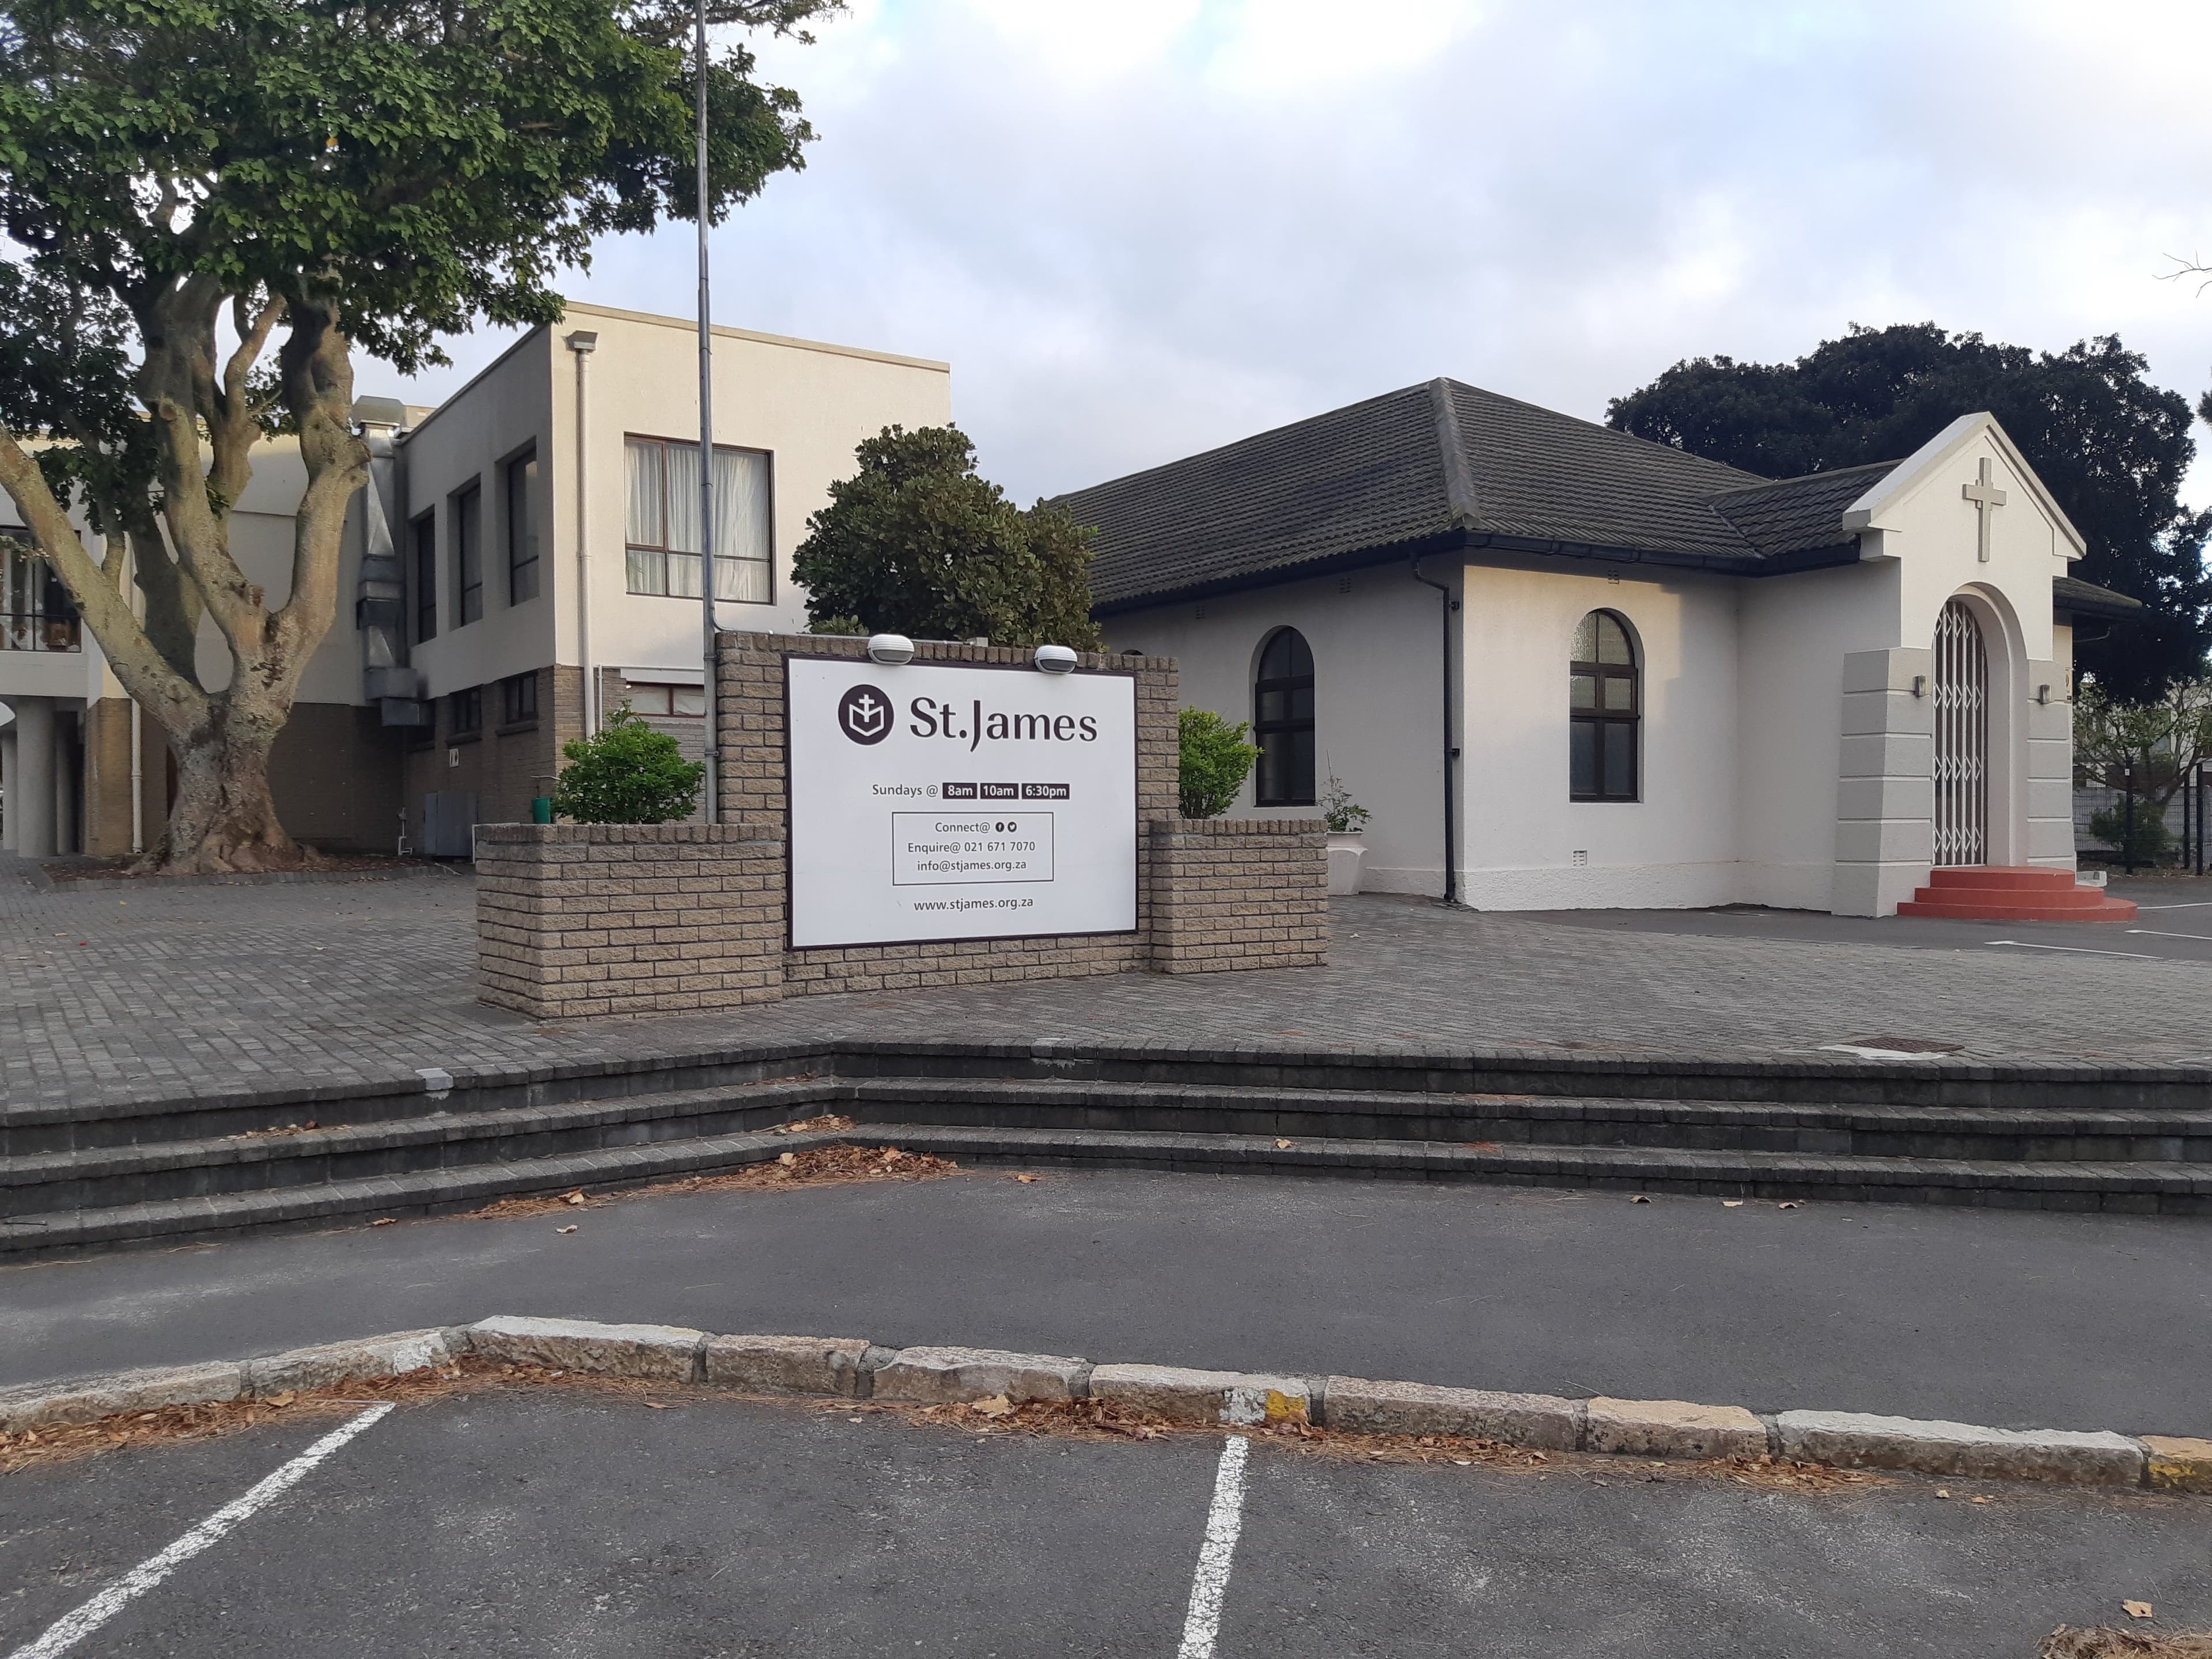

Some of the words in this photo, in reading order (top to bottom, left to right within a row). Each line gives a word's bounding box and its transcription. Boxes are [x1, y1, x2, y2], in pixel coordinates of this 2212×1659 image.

[872, 783, 923, 799] Sundays
[925, 784, 939, 798] @
[948, 785, 974, 797] 8am
[983, 785, 1014, 797] 10am
[1025, 785, 1067, 799] 6:30pm
[934, 821, 991, 835] Connect@
[907, 841, 961, 855] Enquire@
[964, 841, 983, 853] 021
[987, 841, 1006, 852] 671
[1009, 840, 1036, 852] 7070
[917, 859, 1027, 873] info@stjames.org.za
[913, 897, 1034, 913] www.stjames.org.za
